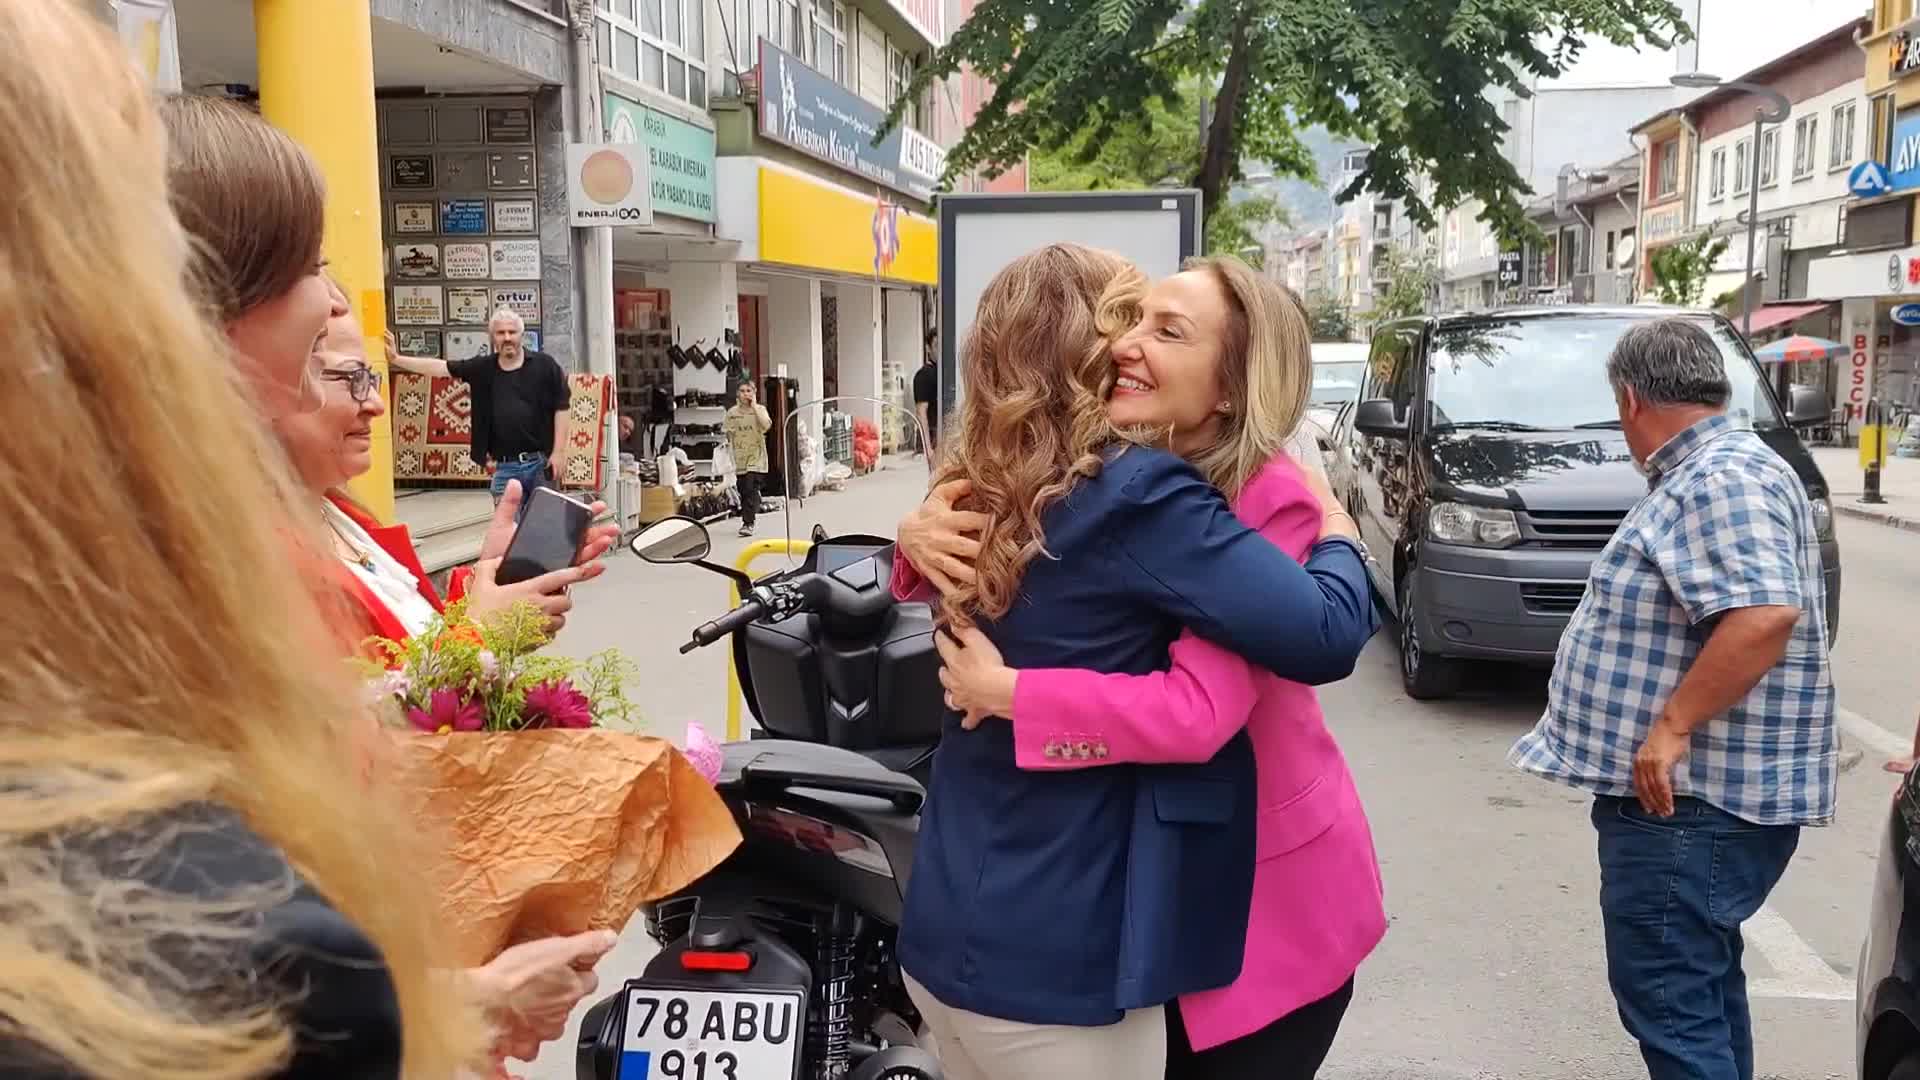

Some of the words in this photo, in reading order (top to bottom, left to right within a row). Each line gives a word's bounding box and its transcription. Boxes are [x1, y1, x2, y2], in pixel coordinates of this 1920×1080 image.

[1896, 134, 1920, 173] AY
[1499, 252, 1520, 261] PASTA
[1500, 271, 1518, 281] CAFE
[496, 292, 533, 301] artur
[1849, 334, 1867, 419] BOSCH
[636, 997, 689, 1040] 78
[700, 1000, 792, 1044] ABU
[660, 1050, 739, 1080] 913
